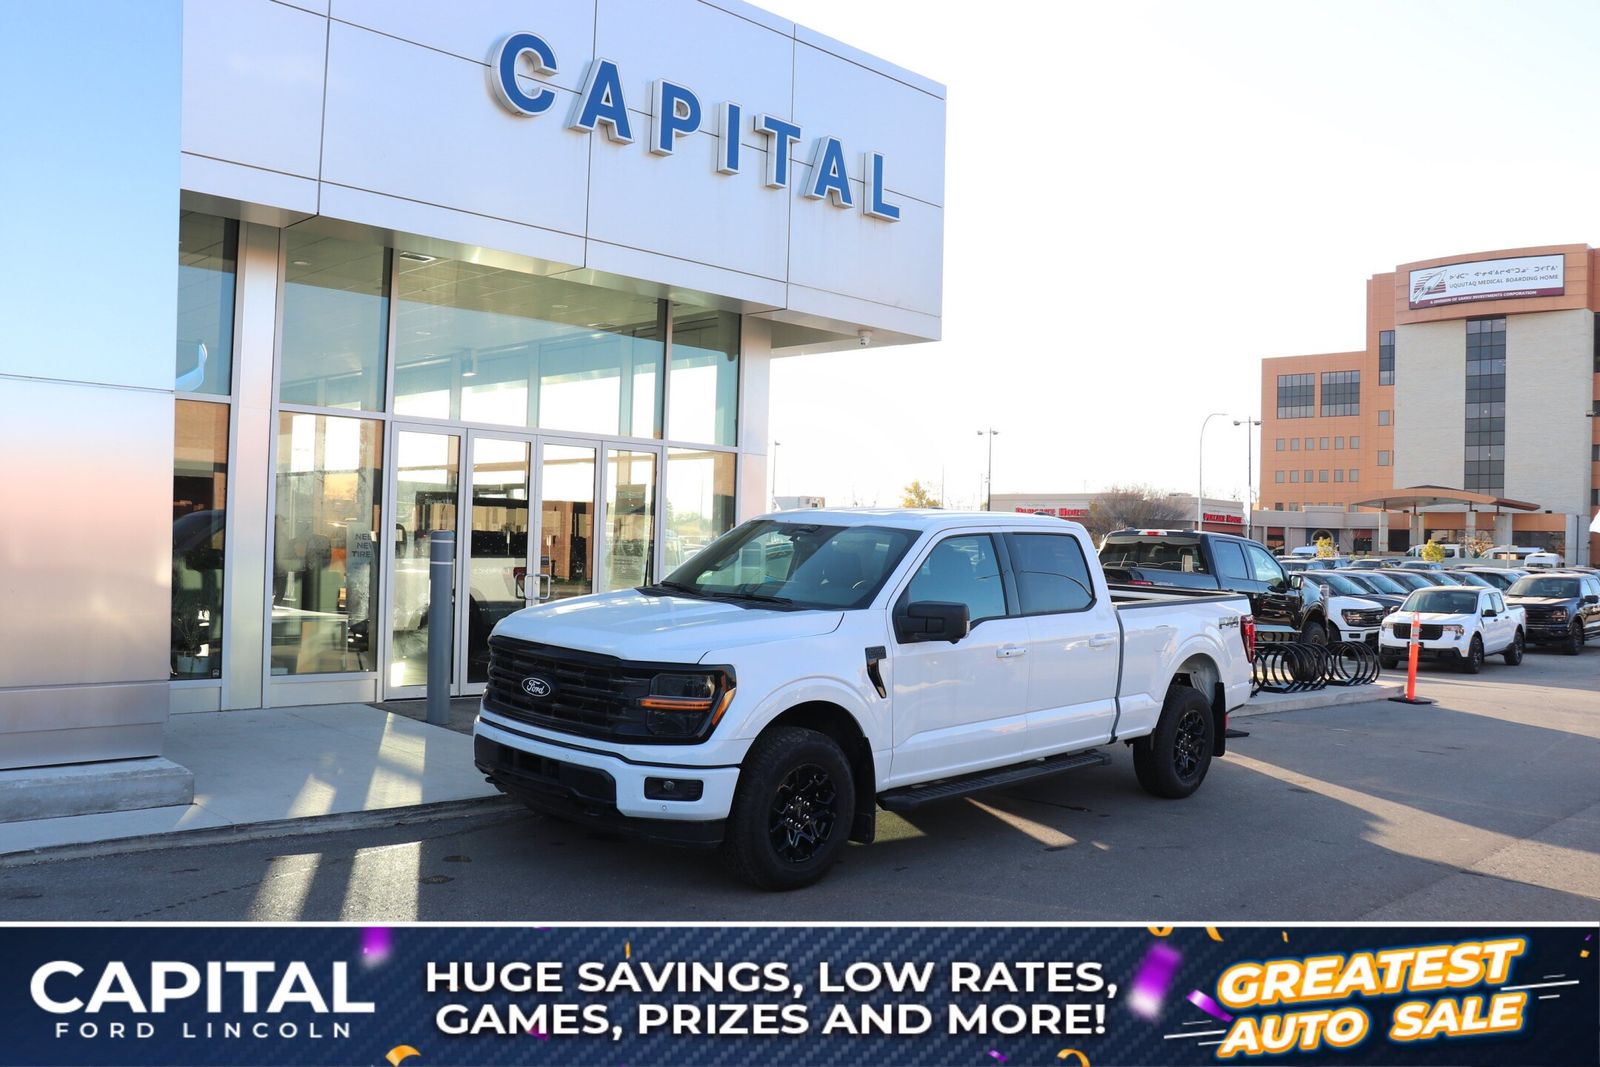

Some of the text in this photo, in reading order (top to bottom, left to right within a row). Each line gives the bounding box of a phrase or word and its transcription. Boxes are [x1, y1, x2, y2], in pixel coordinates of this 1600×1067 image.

[485, 30, 901, 222] CAPITAL
[1478, 278, 1503, 286] MEDICAL
[1505, 275, 1538, 284] BOARDING
[1539, 273, 1559, 281] HOME
